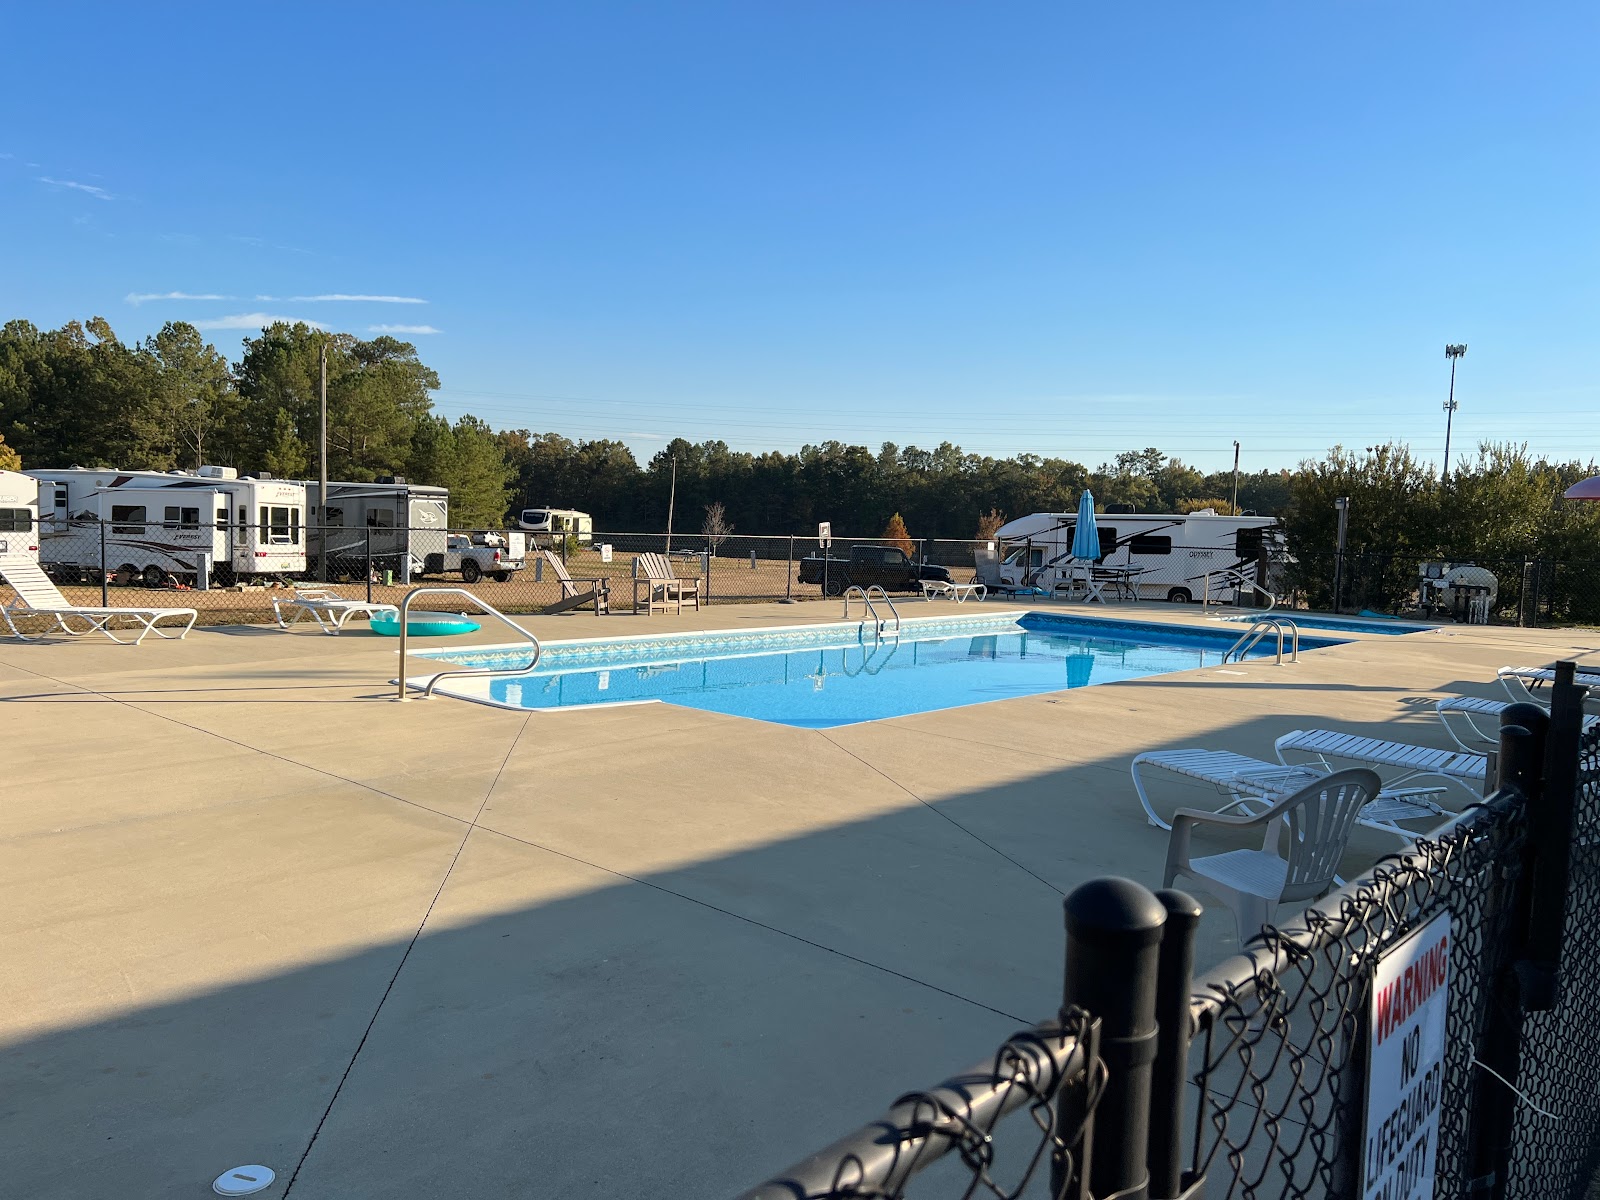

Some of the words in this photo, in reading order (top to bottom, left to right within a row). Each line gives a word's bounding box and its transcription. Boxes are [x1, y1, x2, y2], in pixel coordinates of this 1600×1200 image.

[1189, 551, 1214, 559] ODYSSEY
[1377, 935, 1447, 1046] WARNING
[1400, 1024, 1420, 1091] NO
[1366, 1061, 1440, 1194] LIFEGUARD
[1395, 1126, 1430, 1200] DUTY
